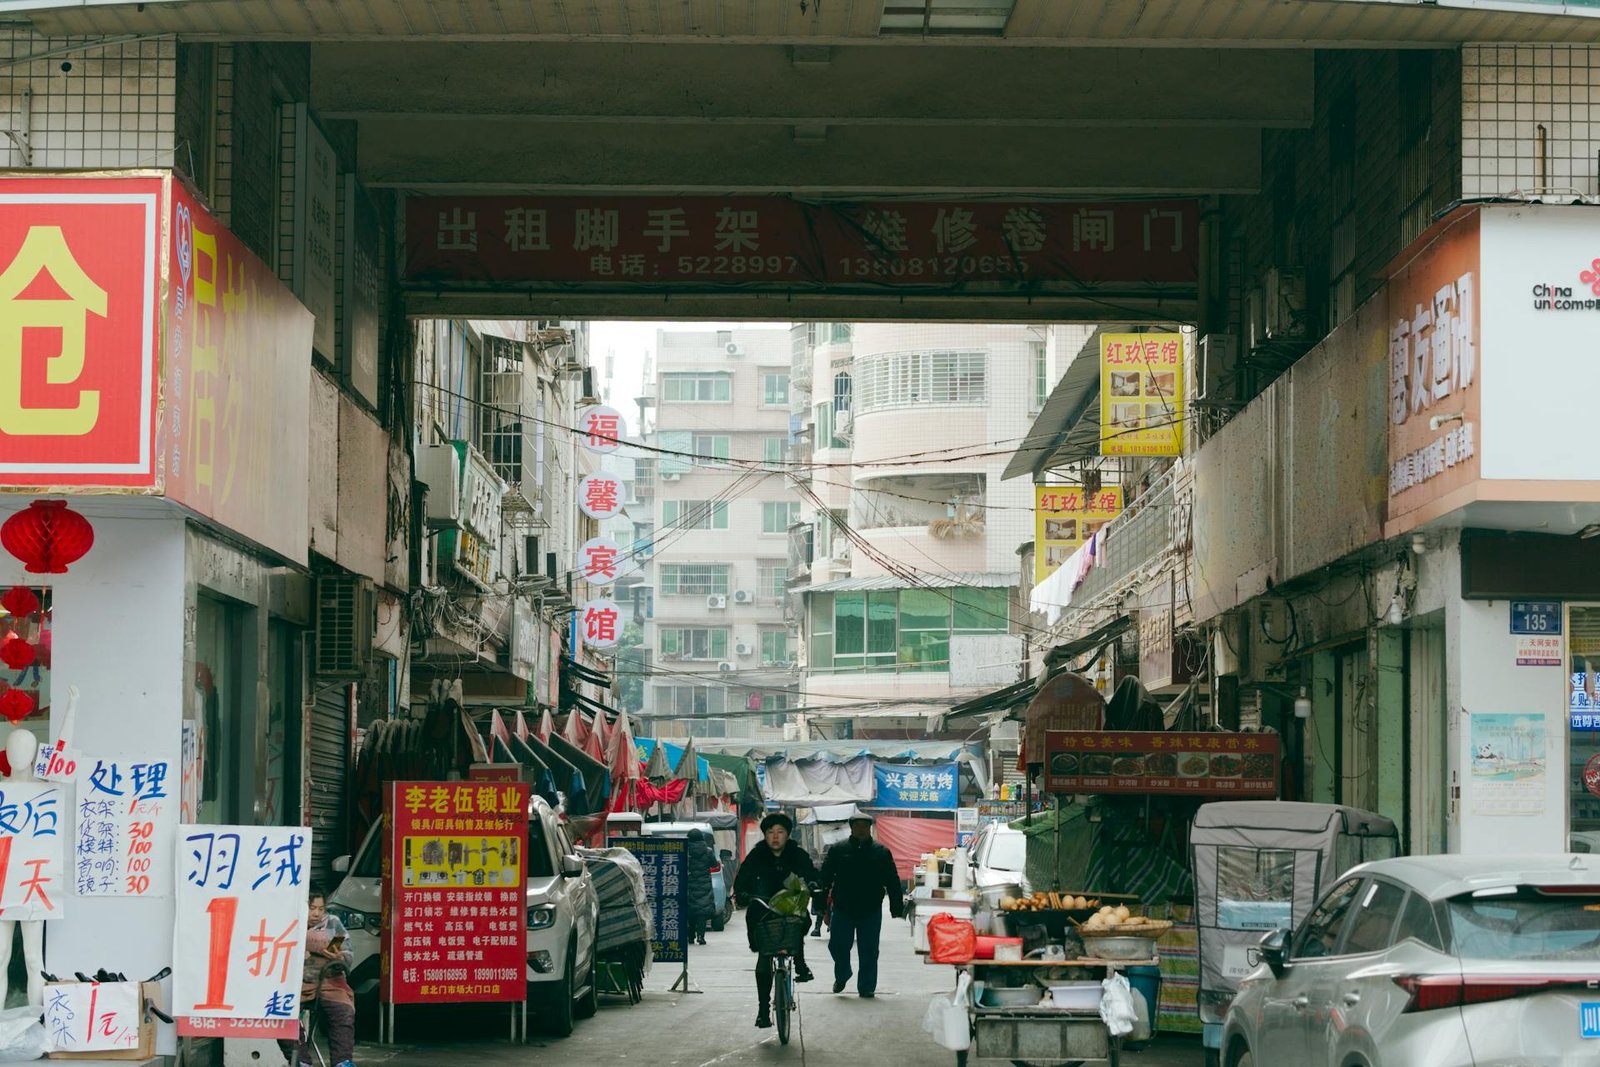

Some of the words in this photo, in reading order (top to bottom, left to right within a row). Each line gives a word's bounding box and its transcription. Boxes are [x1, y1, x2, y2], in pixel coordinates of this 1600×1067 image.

[435, 207, 761, 253] 出租脚手架
[862, 208, 1182, 253] 维修卷闸门
[1532, 283, 1572, 297] China
[0, 225, 108, 435] 仓
[1107, 340, 1178, 364] 红玖宾馆
[584, 413, 619, 641] 福馨宾馆
[1524, 614, 1546, 631] 135
[88, 760, 168, 800] 处理
[885, 772, 953, 790] 兴鑫烧烤
[405, 785, 521, 814] 李老伍锁业
[898, 791, 939, 802] 欢迎光临
[128, 821, 154, 839] 30
[127, 839, 153, 857] 100
[126, 857, 151, 874] 100
[186, 833, 304, 891] 羽绒
[125, 875, 150, 895] 30
[264, 990, 296, 1018] 起
